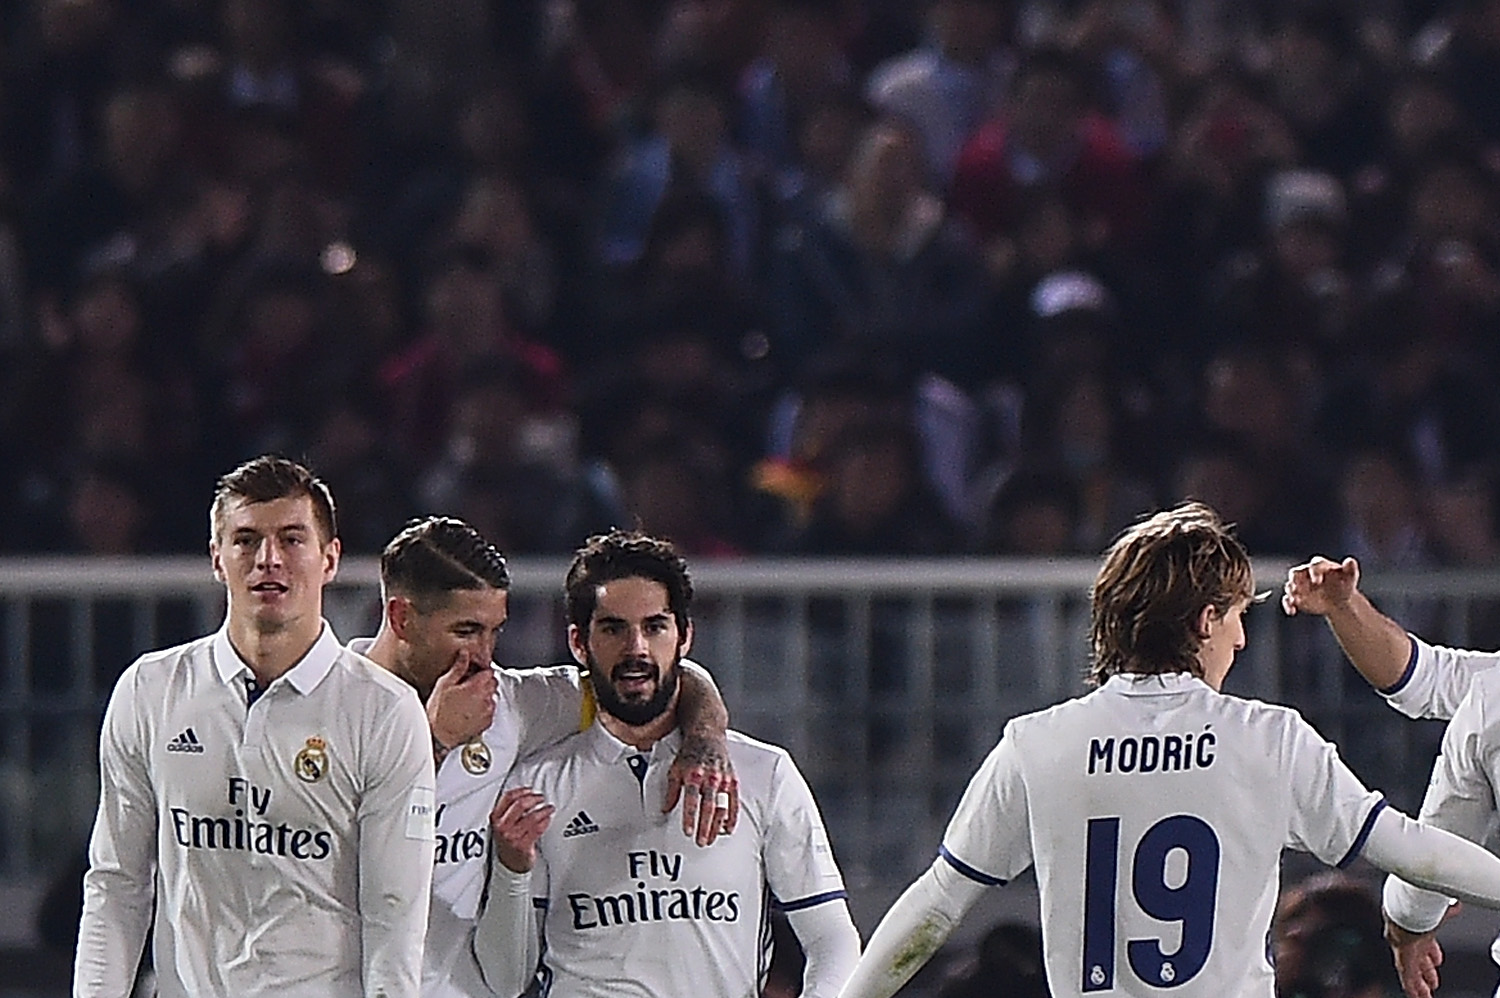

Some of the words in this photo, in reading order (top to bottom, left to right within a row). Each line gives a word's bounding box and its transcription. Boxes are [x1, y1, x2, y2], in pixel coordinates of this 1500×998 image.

[228, 778, 271, 815] Fly
[171, 808, 331, 860] Emirates
[435, 828, 486, 864] ates
[627, 850, 682, 882] Fly
[568, 883, 739, 930] Emirates
[1082, 814, 1221, 993] 19
